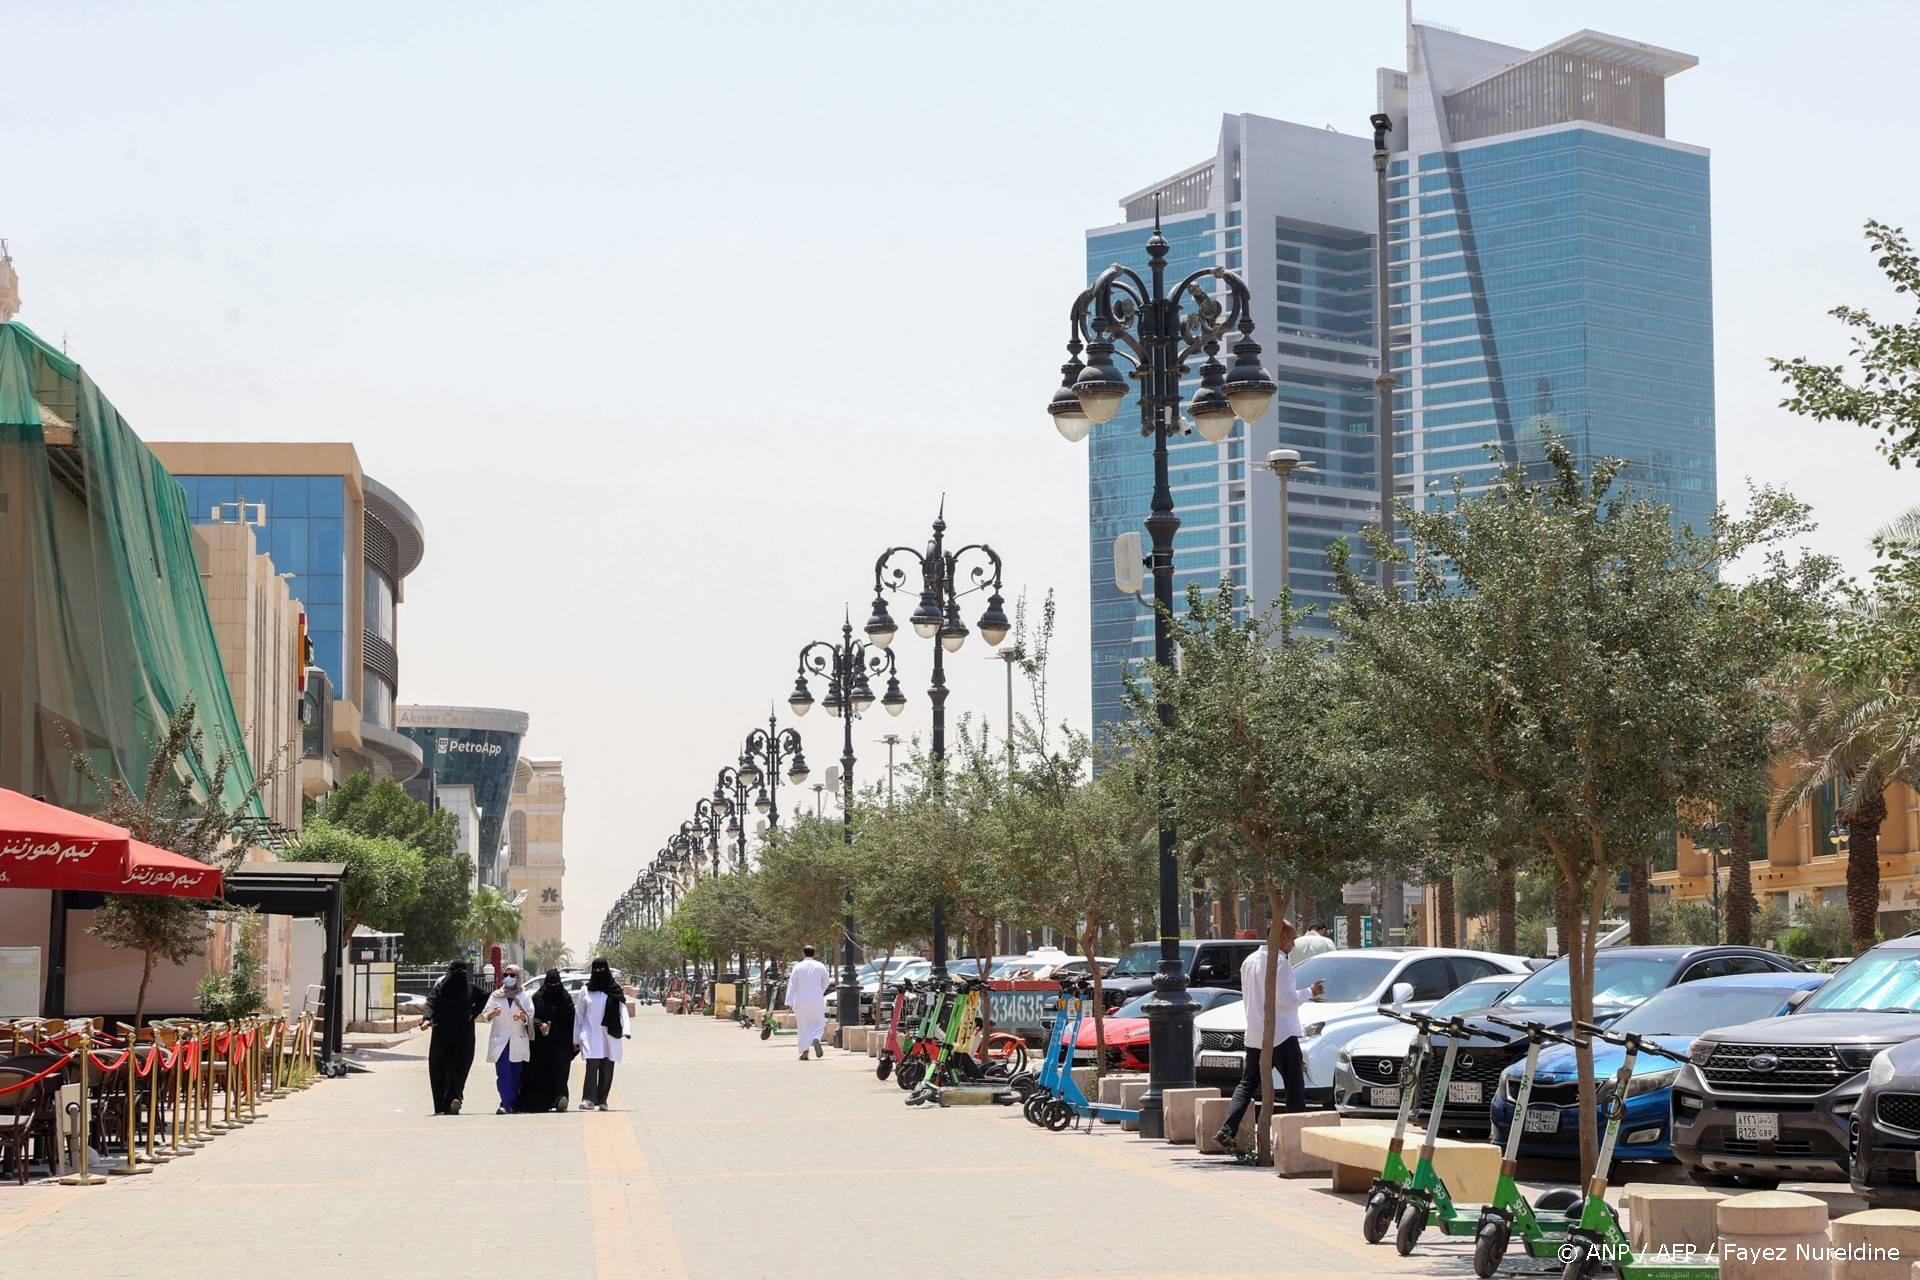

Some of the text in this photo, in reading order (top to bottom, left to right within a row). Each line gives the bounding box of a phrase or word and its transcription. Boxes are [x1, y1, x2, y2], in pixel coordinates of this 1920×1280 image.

[449, 741, 502, 757] PetroApp
[56, 841, 99, 864] تيم
[172, 872, 205, 889] تيم
